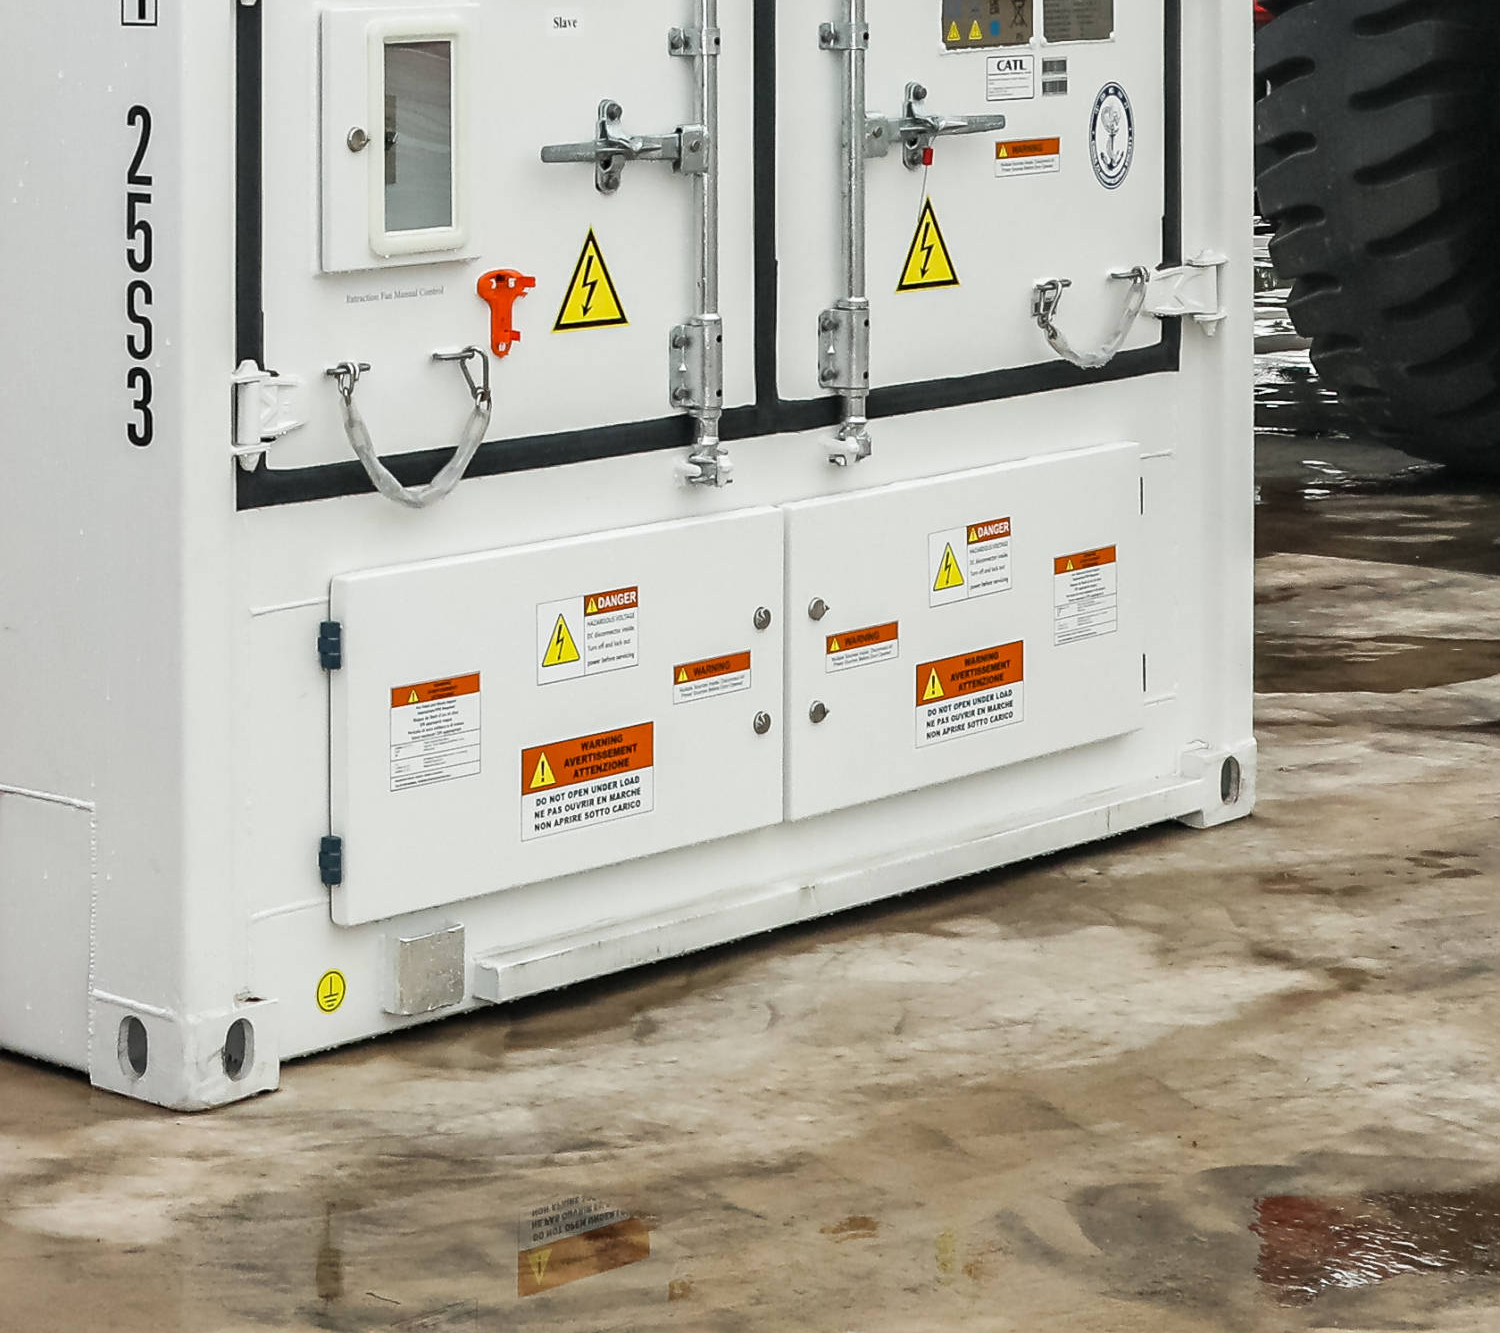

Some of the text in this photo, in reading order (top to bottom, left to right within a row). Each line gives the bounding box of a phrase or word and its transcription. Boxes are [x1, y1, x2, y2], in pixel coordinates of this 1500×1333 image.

[552, 16, 578, 29] Slave
[996, 59, 1027, 72] CATL
[126, 105, 153, 447] 25S3
[977, 520, 1010, 538] DANGER
[597, 591, 637, 609] DANGER
[927, 689, 1013, 717] DO NOT OPEN UNDER LOAD
[926, 730, 941, 740] NON
[967, 717, 988, 729] SOTTO
[989, 711, 1014, 723] CARICO
[937, 716, 949, 726] PAS
[977, 706, 986, 716] EN
[581, 734, 623, 752] WARNING
[564, 743, 638, 768] AVERTISSEMENT
[573, 758, 630, 779] ATTENZIONE
[535, 775, 640, 807] DO NOT OPEN UNDER LOAD
[534, 787, 641, 819] NE PAS OUVRIR EN MARCHE
[534, 799, 641, 832] NON APRIRE SOTTO CARICO
